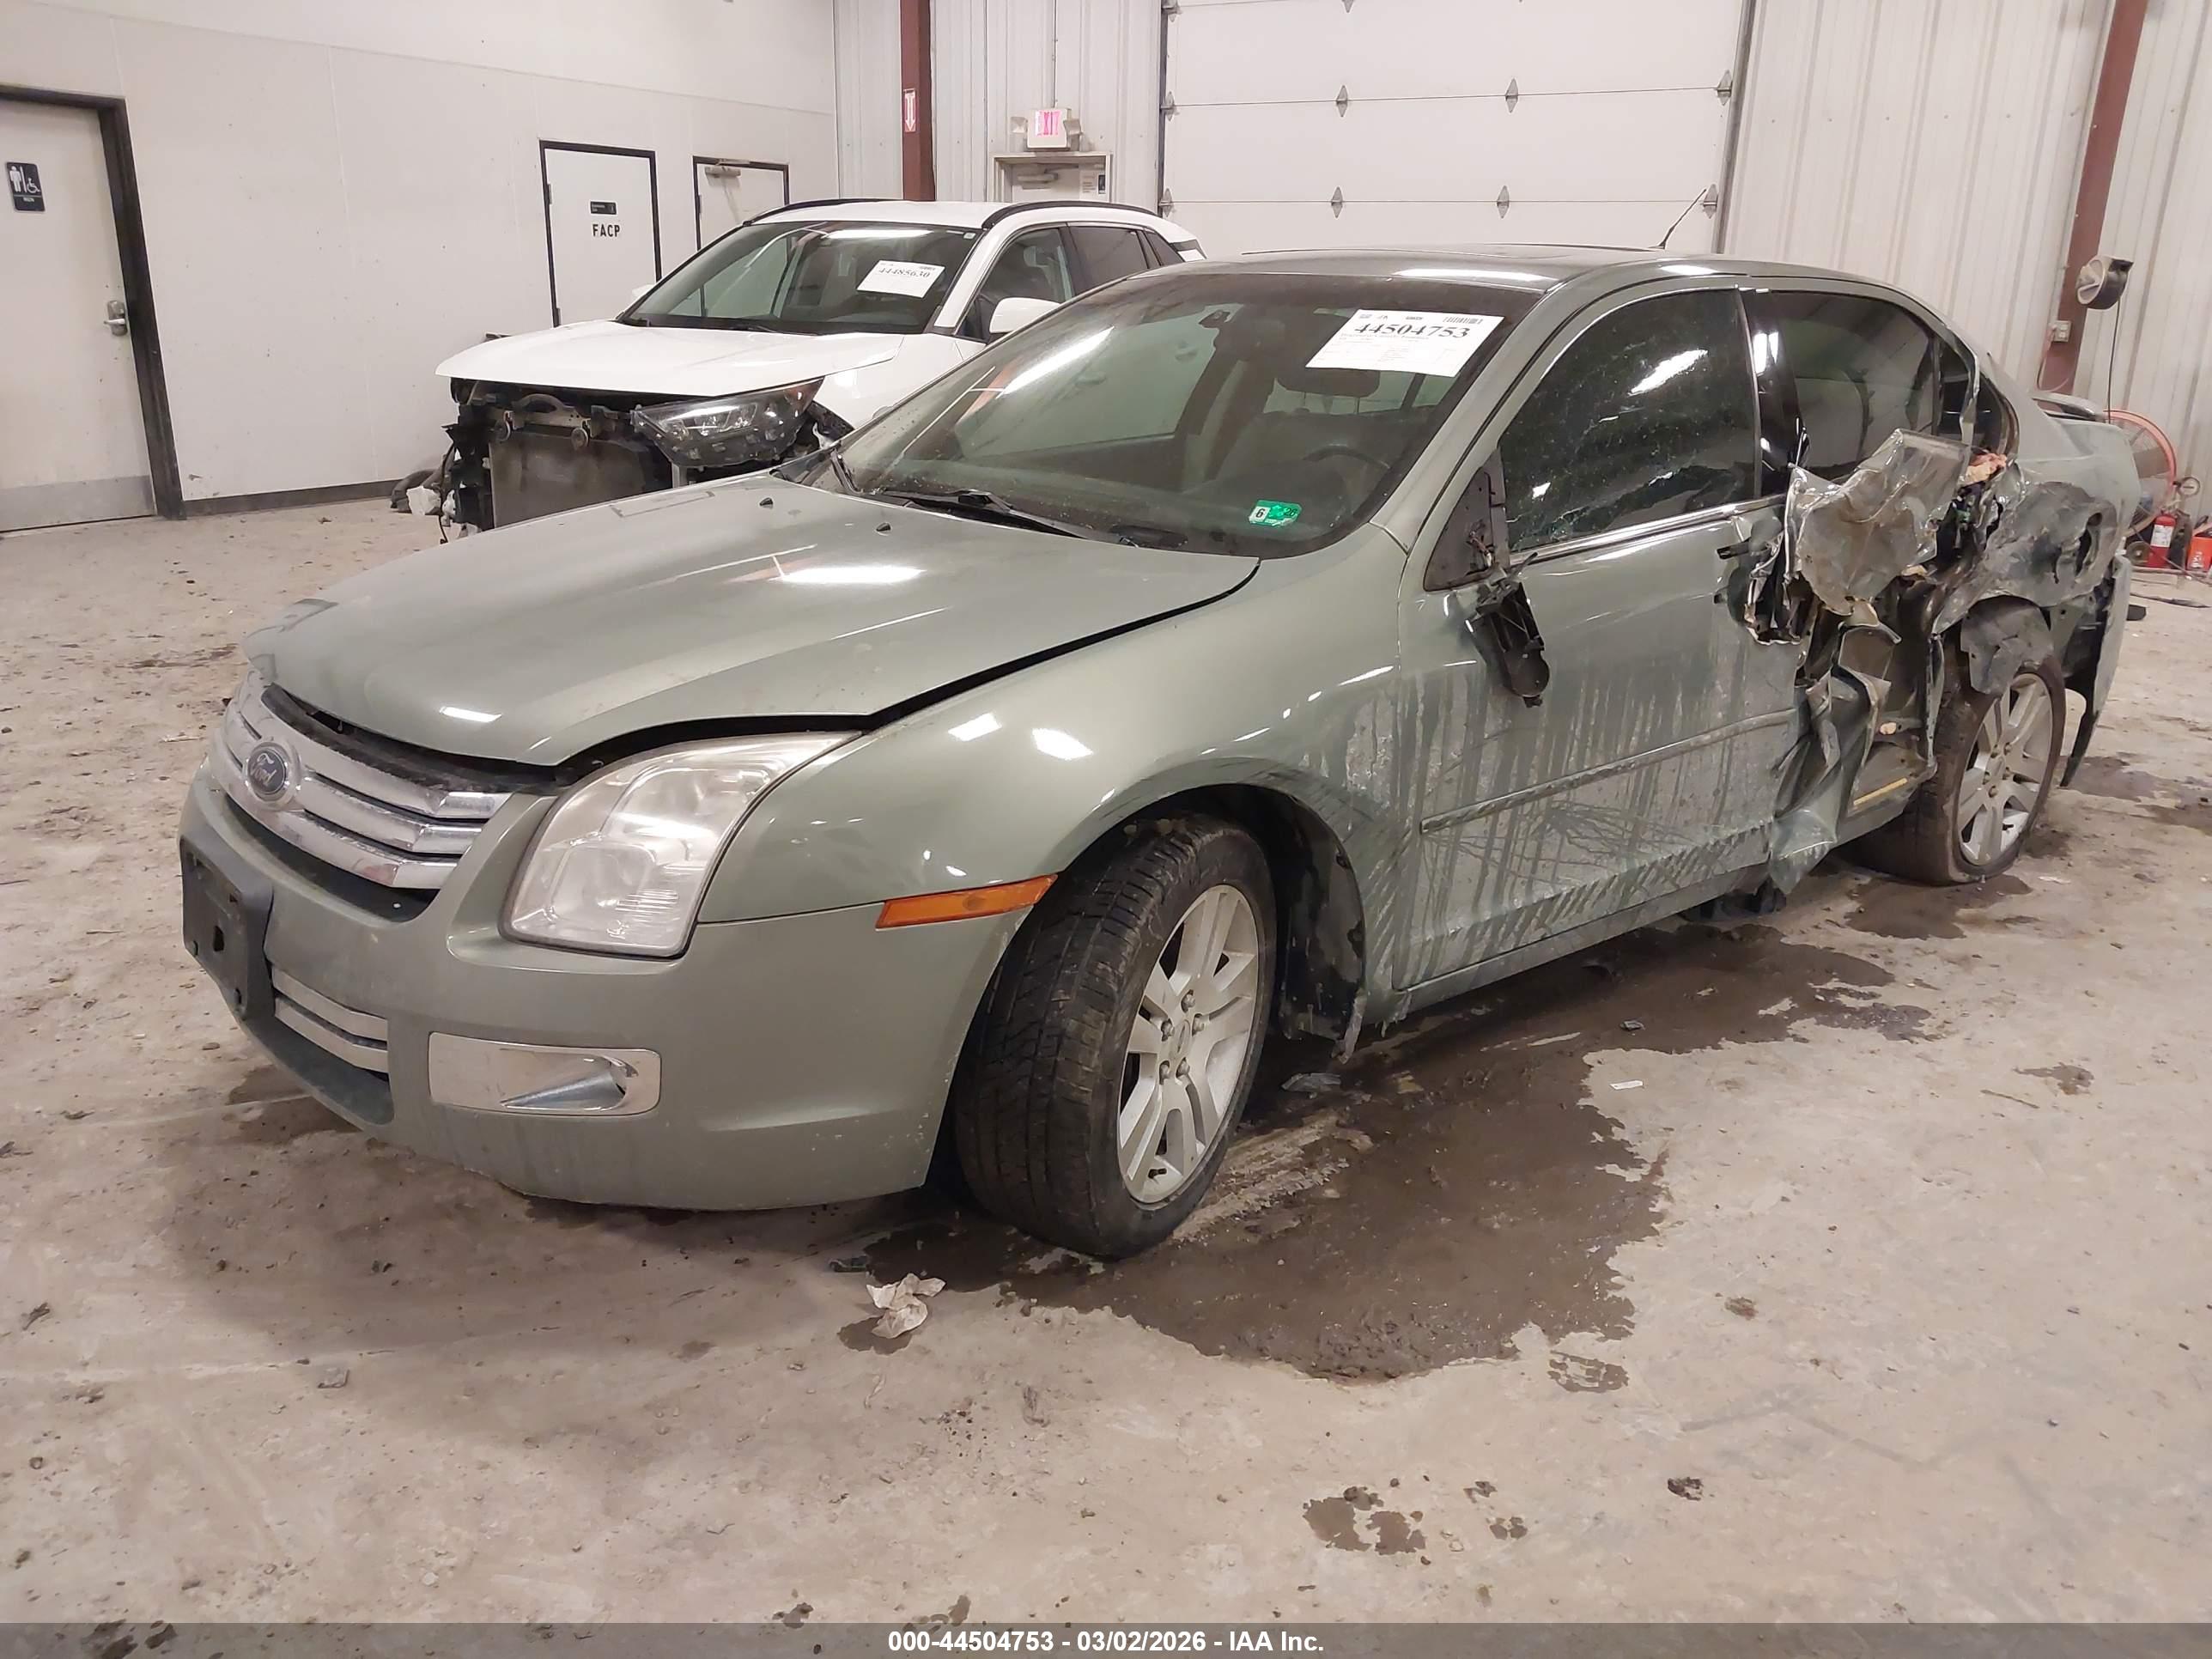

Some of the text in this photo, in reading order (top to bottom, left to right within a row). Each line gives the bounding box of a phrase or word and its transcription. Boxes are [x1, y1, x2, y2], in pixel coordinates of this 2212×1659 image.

[592, 223, 620, 237] FACP
[1354, 323, 1471, 338] 44504753
[1255, 507, 1266, 518] 6
[251, 752, 277, 787] Ford
